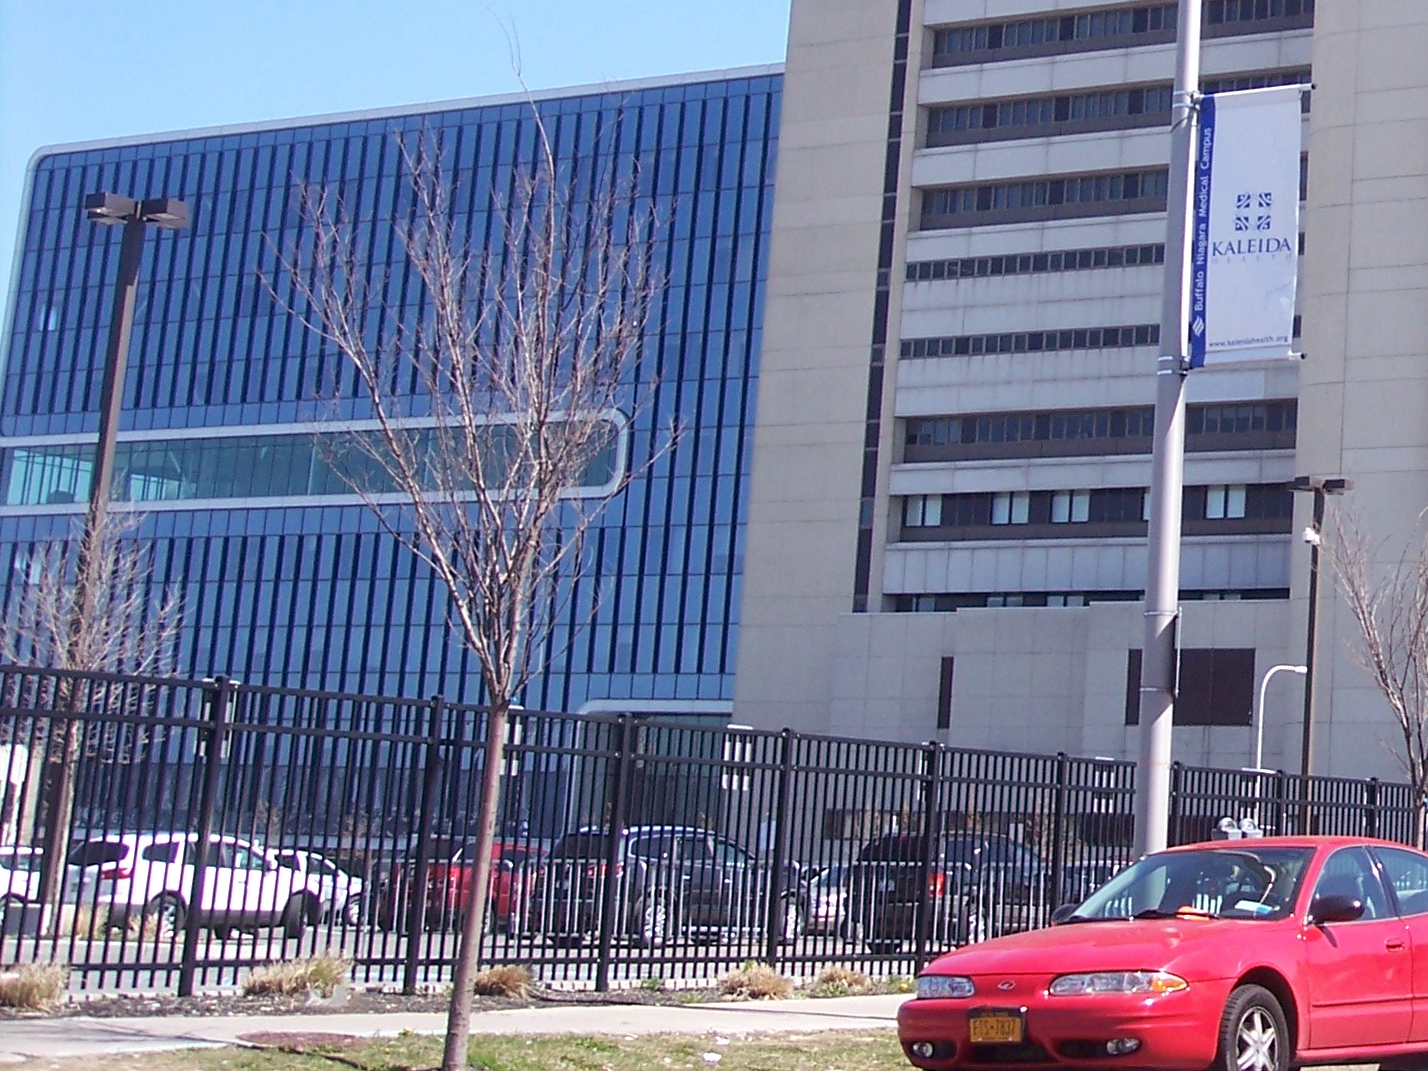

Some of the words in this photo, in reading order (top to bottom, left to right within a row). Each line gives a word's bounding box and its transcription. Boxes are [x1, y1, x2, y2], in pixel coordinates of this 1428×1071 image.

[1200, 127, 1212, 169] Campus
[1198, 175, 1209, 217] Medical
[1196, 222, 1208, 265] Niagara
[1212, 237, 1291, 257] KALEIDA
[1194, 271, 1205, 311] Buffalo
